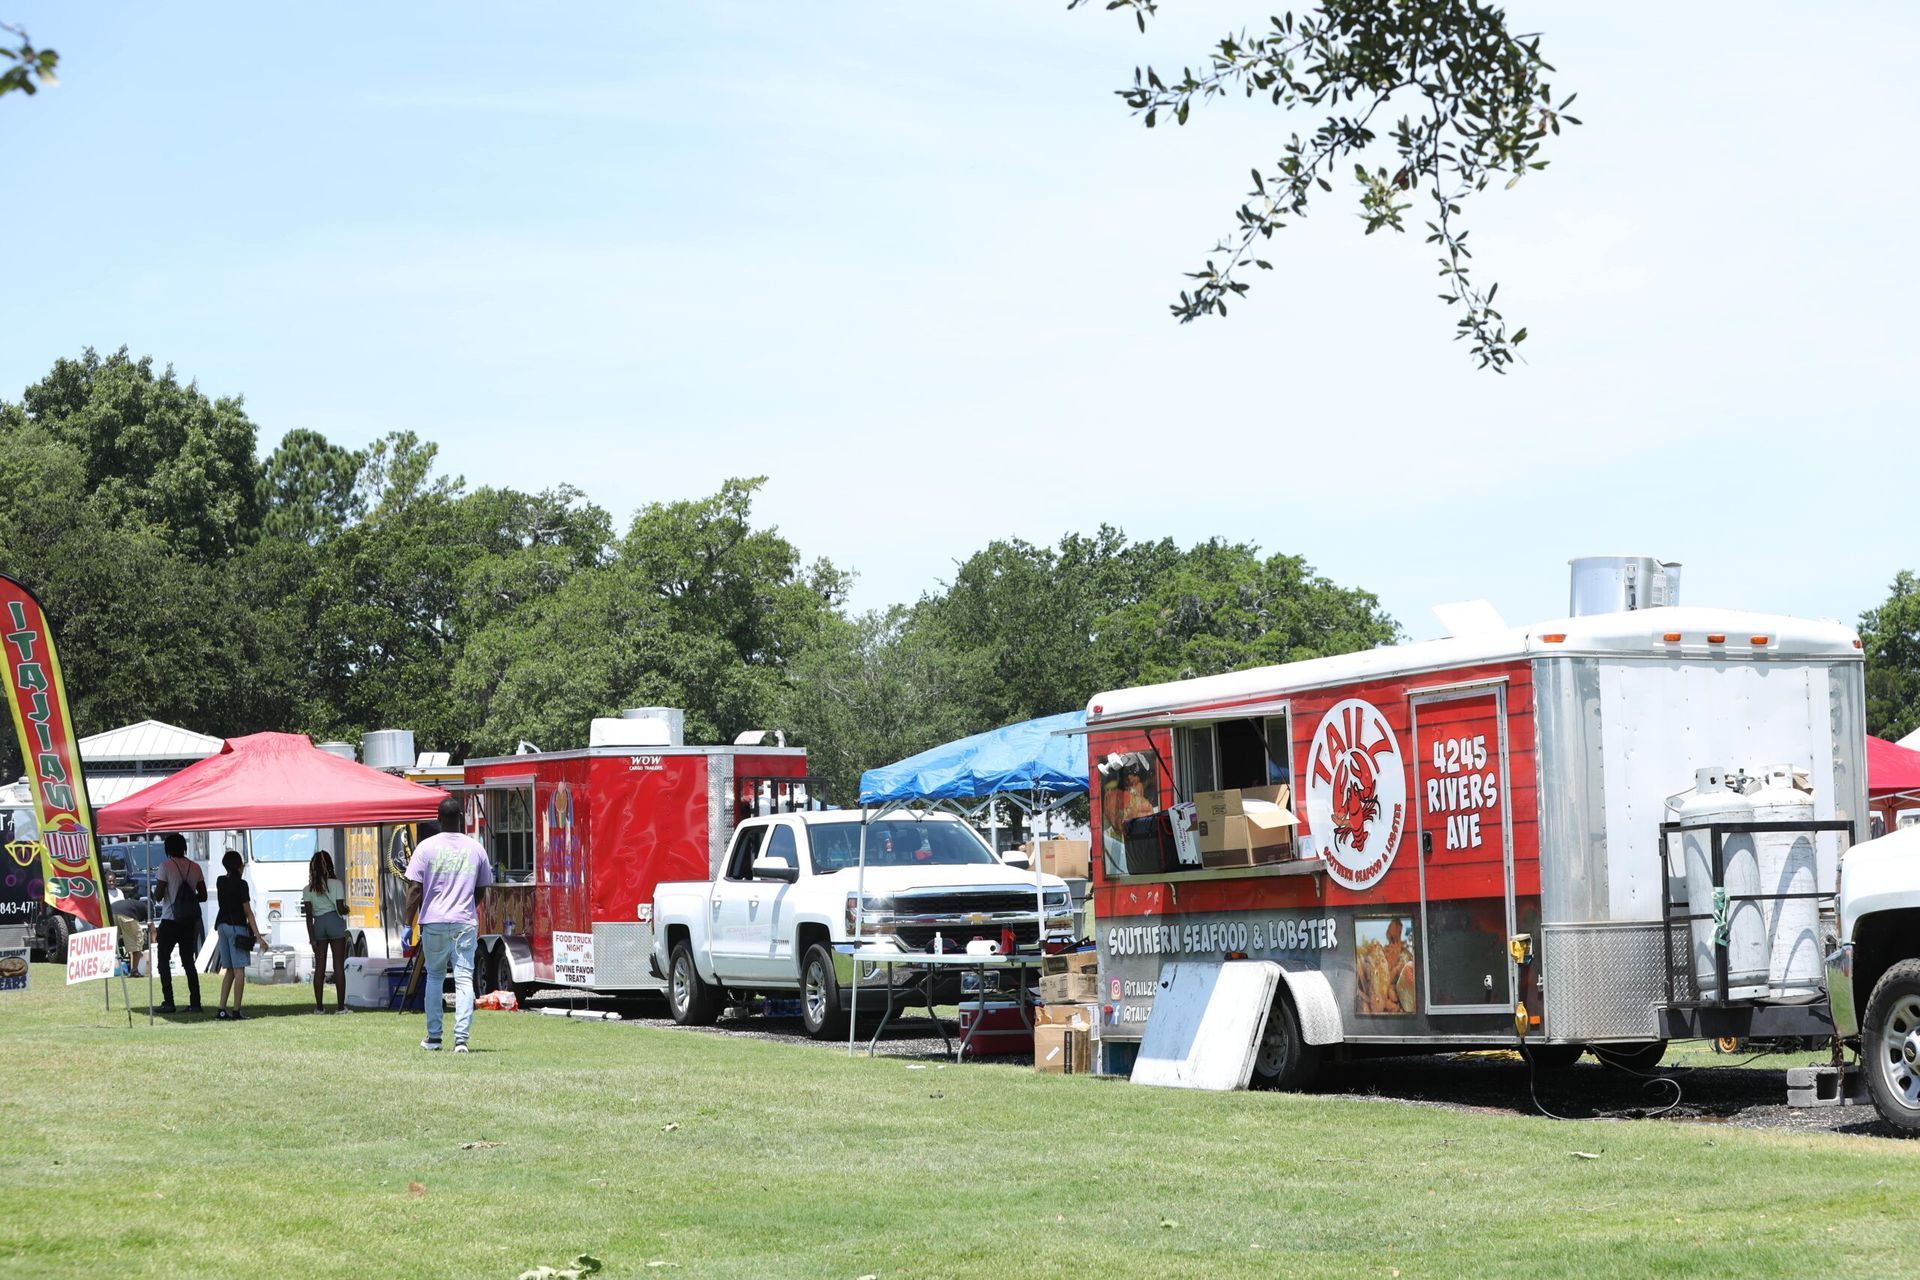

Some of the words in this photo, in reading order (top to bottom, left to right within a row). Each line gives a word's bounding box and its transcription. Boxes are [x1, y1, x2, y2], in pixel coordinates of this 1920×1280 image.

[630, 755, 662, 765] WOW
[1432, 735, 1488, 774] 4245
[1426, 771, 1498, 814] RIVERS
[1323, 846, 1354, 881] SOUTHERN
[1355, 859, 1383, 882] SEAFOOD
[1385, 803, 1402, 853] LOBSTER
[1445, 813, 1483, 851] AVE
[69, 932, 114, 958] FUNNEL
[555, 935, 572, 943] FOOD
[574, 936, 592, 944] TRUCK
[566, 944, 584, 952] NIGHT
[1108, 924, 1180, 956] SOUTHERN
[1183, 921, 1248, 953] SEAFOOD
[1253, 924, 1264, 951] &
[1268, 917, 1338, 950] LOBSTER
[68, 957, 98, 981] CAKES
[555, 965, 575, 973] DIVINE
[576, 966, 594, 974] FAVOR
[565, 974, 586, 983] TREATS
